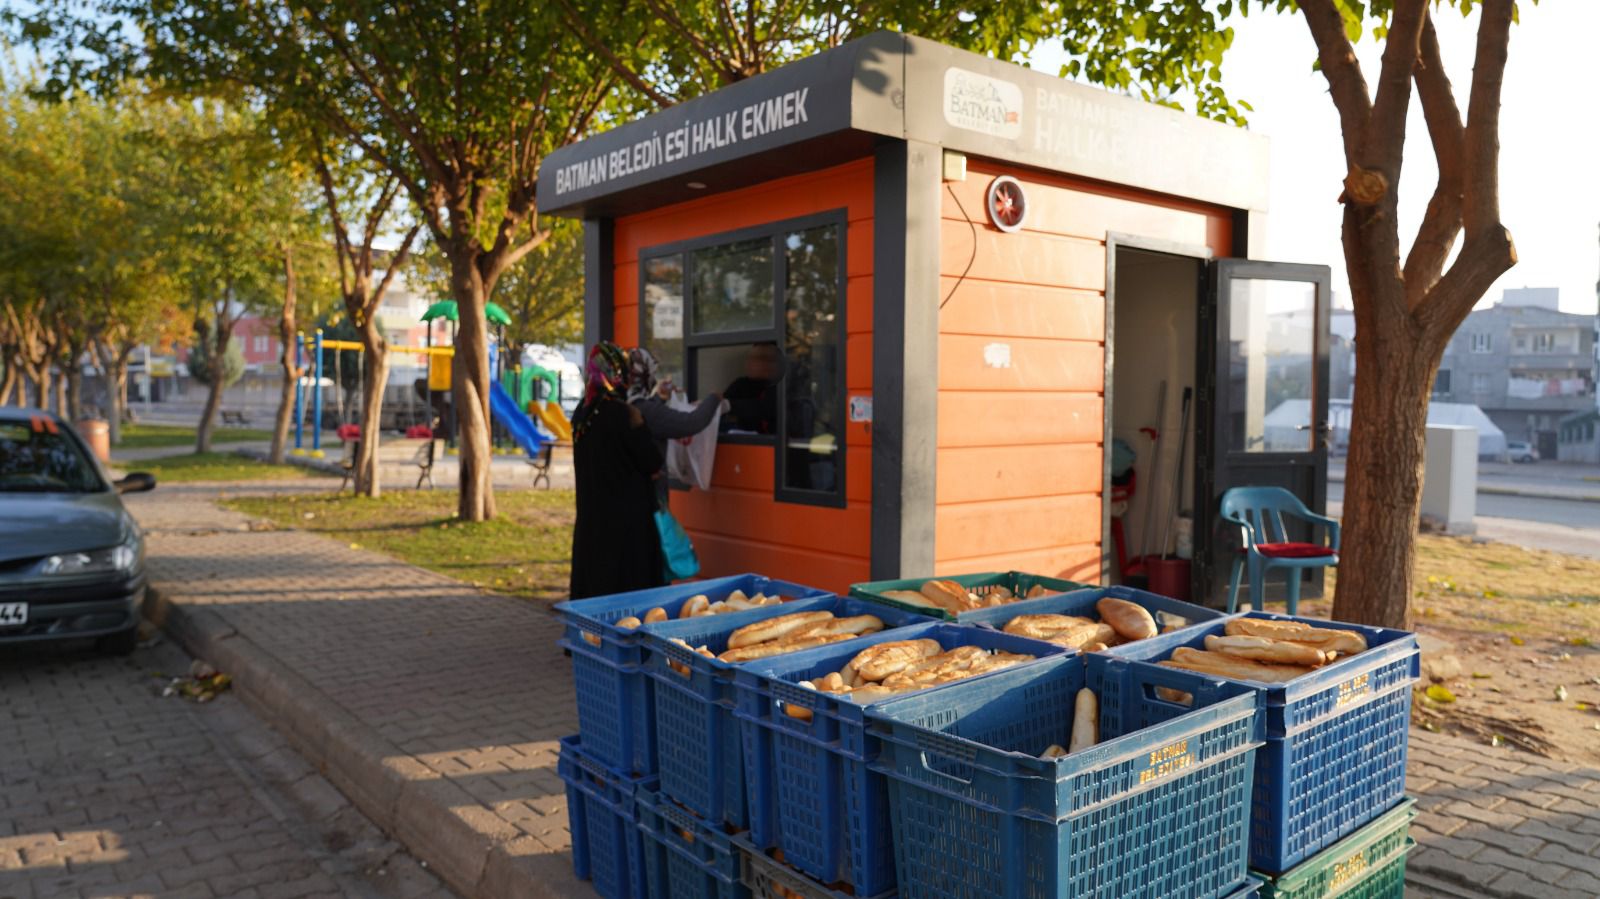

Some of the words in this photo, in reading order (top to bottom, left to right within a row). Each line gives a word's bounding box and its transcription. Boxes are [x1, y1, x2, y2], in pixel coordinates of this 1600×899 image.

[950, 94, 1008, 124] BATMAN
[1035, 88, 1107, 124] BATMAN
[555, 154, 608, 195] BATMAN
[691, 111, 738, 156] HALK
[741, 87, 809, 140] EKMEK
[1034, 116, 1108, 160] HALK
[1150, 739, 1187, 766] BATMAN
